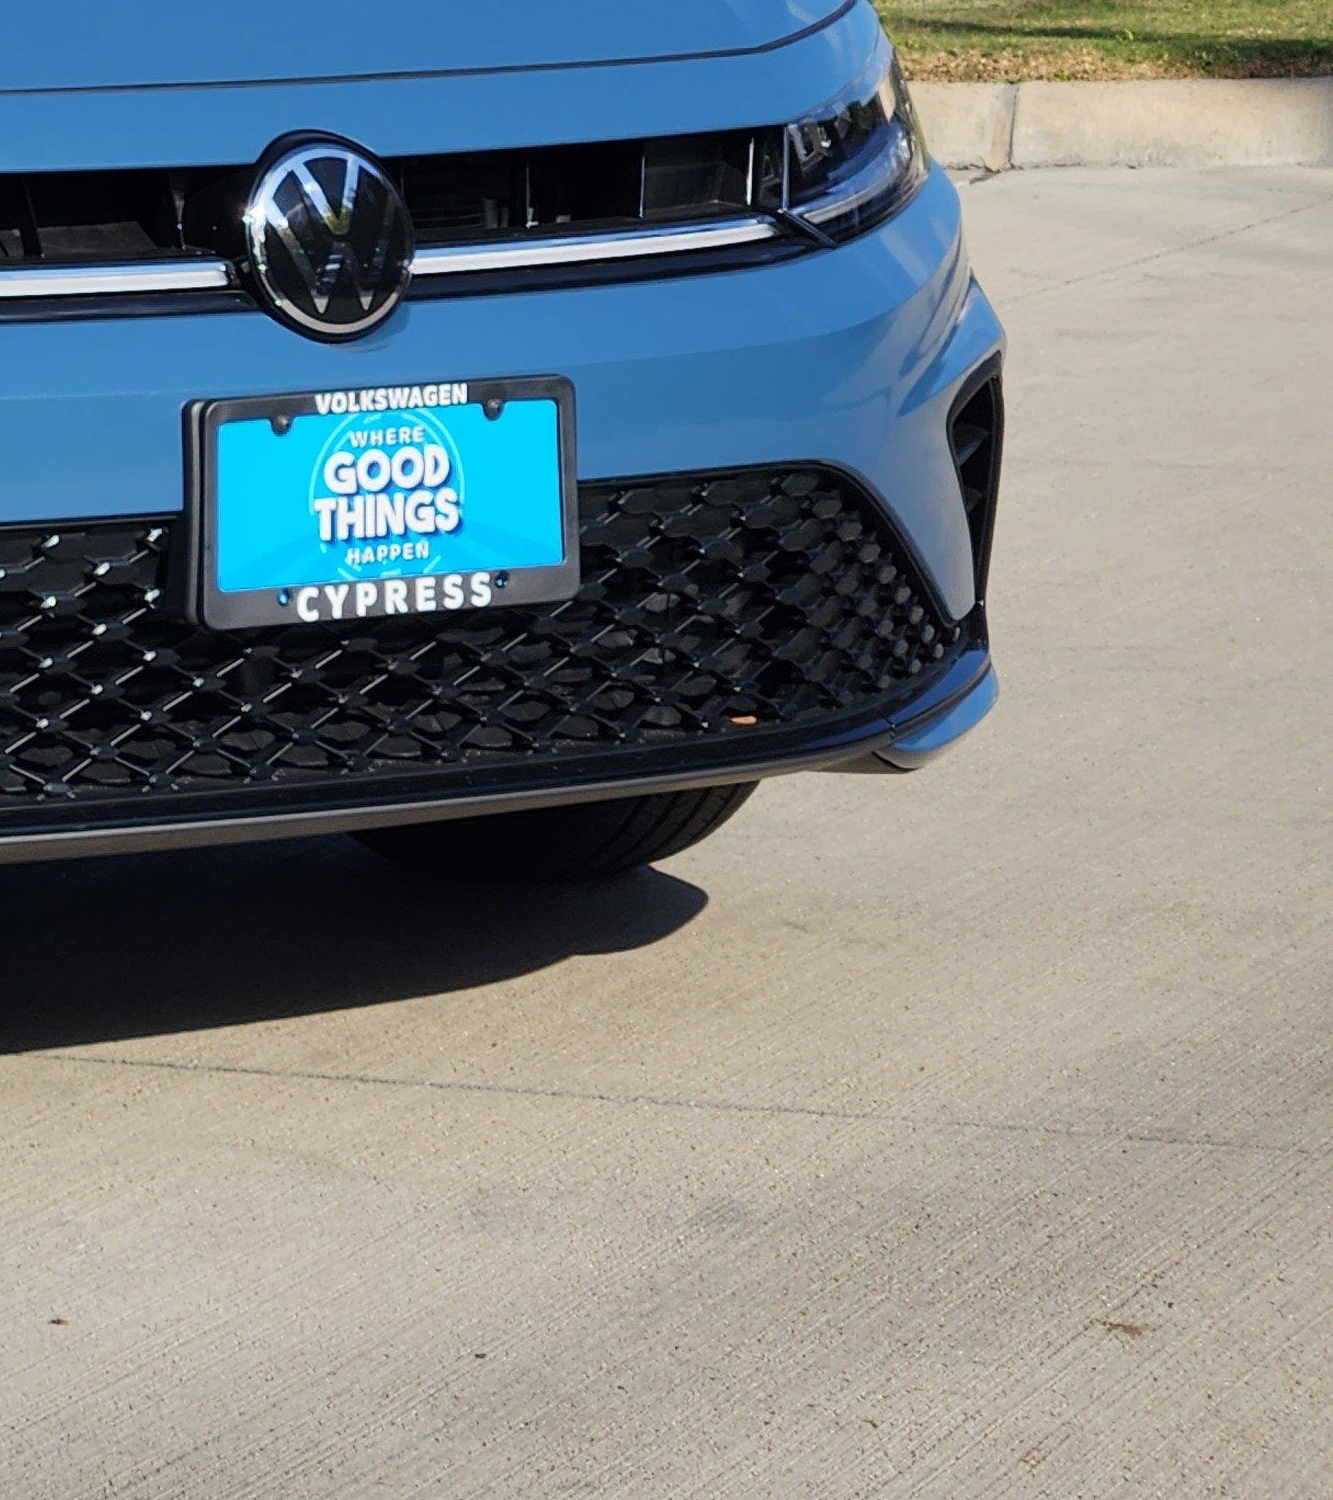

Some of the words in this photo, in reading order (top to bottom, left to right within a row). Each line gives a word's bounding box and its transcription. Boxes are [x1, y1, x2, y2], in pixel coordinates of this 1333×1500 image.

[315, 383, 468, 415] VOLKSWAGEN
[349, 426, 425, 448] WHERE
[323, 443, 450, 495] GOOD
[313, 487, 460, 542] THINGS
[344, 539, 430, 565] HAPPEN
[296, 572, 493, 622] CYPRESS
